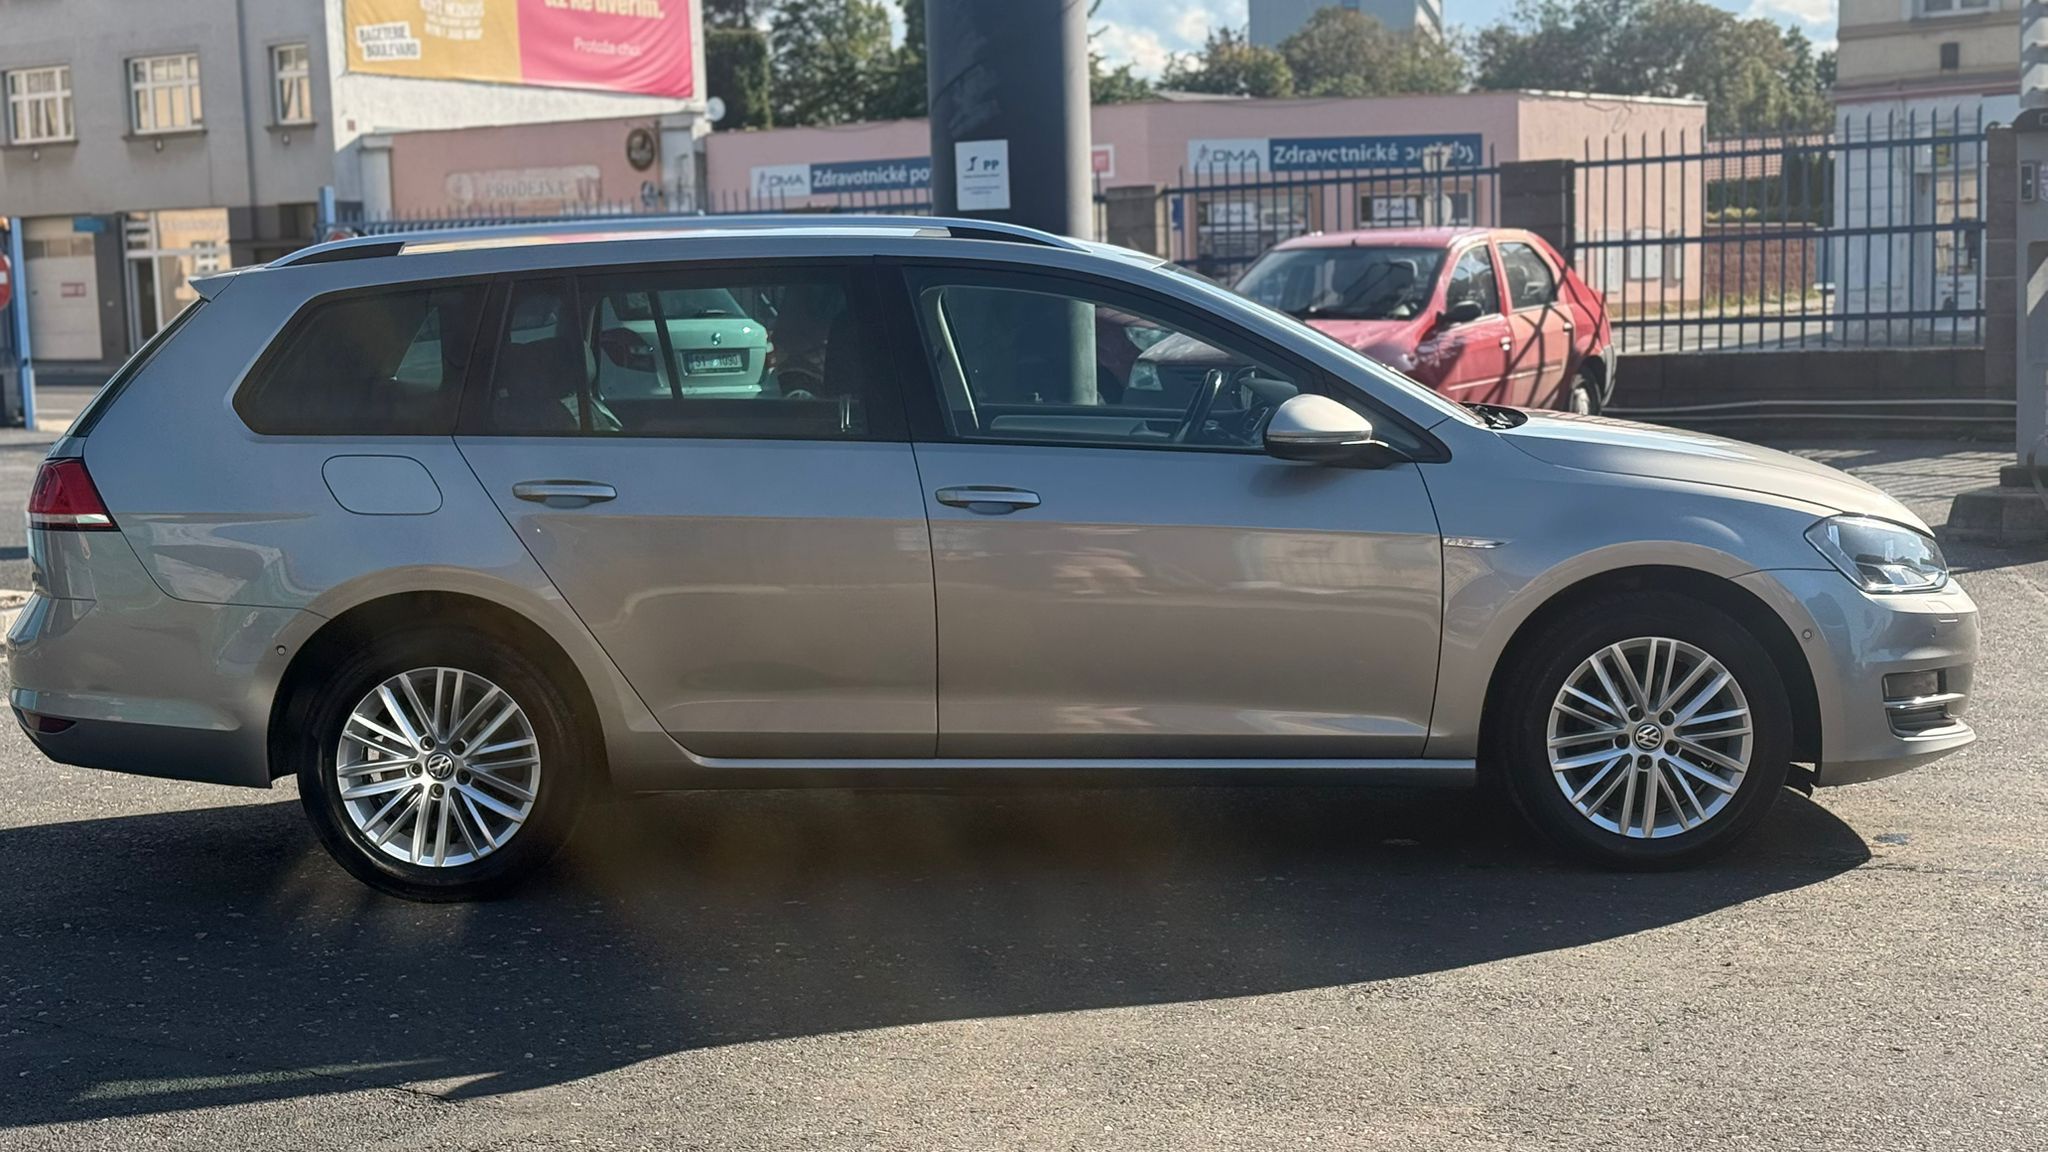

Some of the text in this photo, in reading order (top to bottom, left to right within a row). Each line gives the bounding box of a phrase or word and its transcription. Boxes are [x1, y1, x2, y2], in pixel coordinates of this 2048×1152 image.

[1274, 143, 1398, 164] Zdravotnické
[812, 164, 907, 188] Zdravotnické
[910, 167, 932, 185] po
